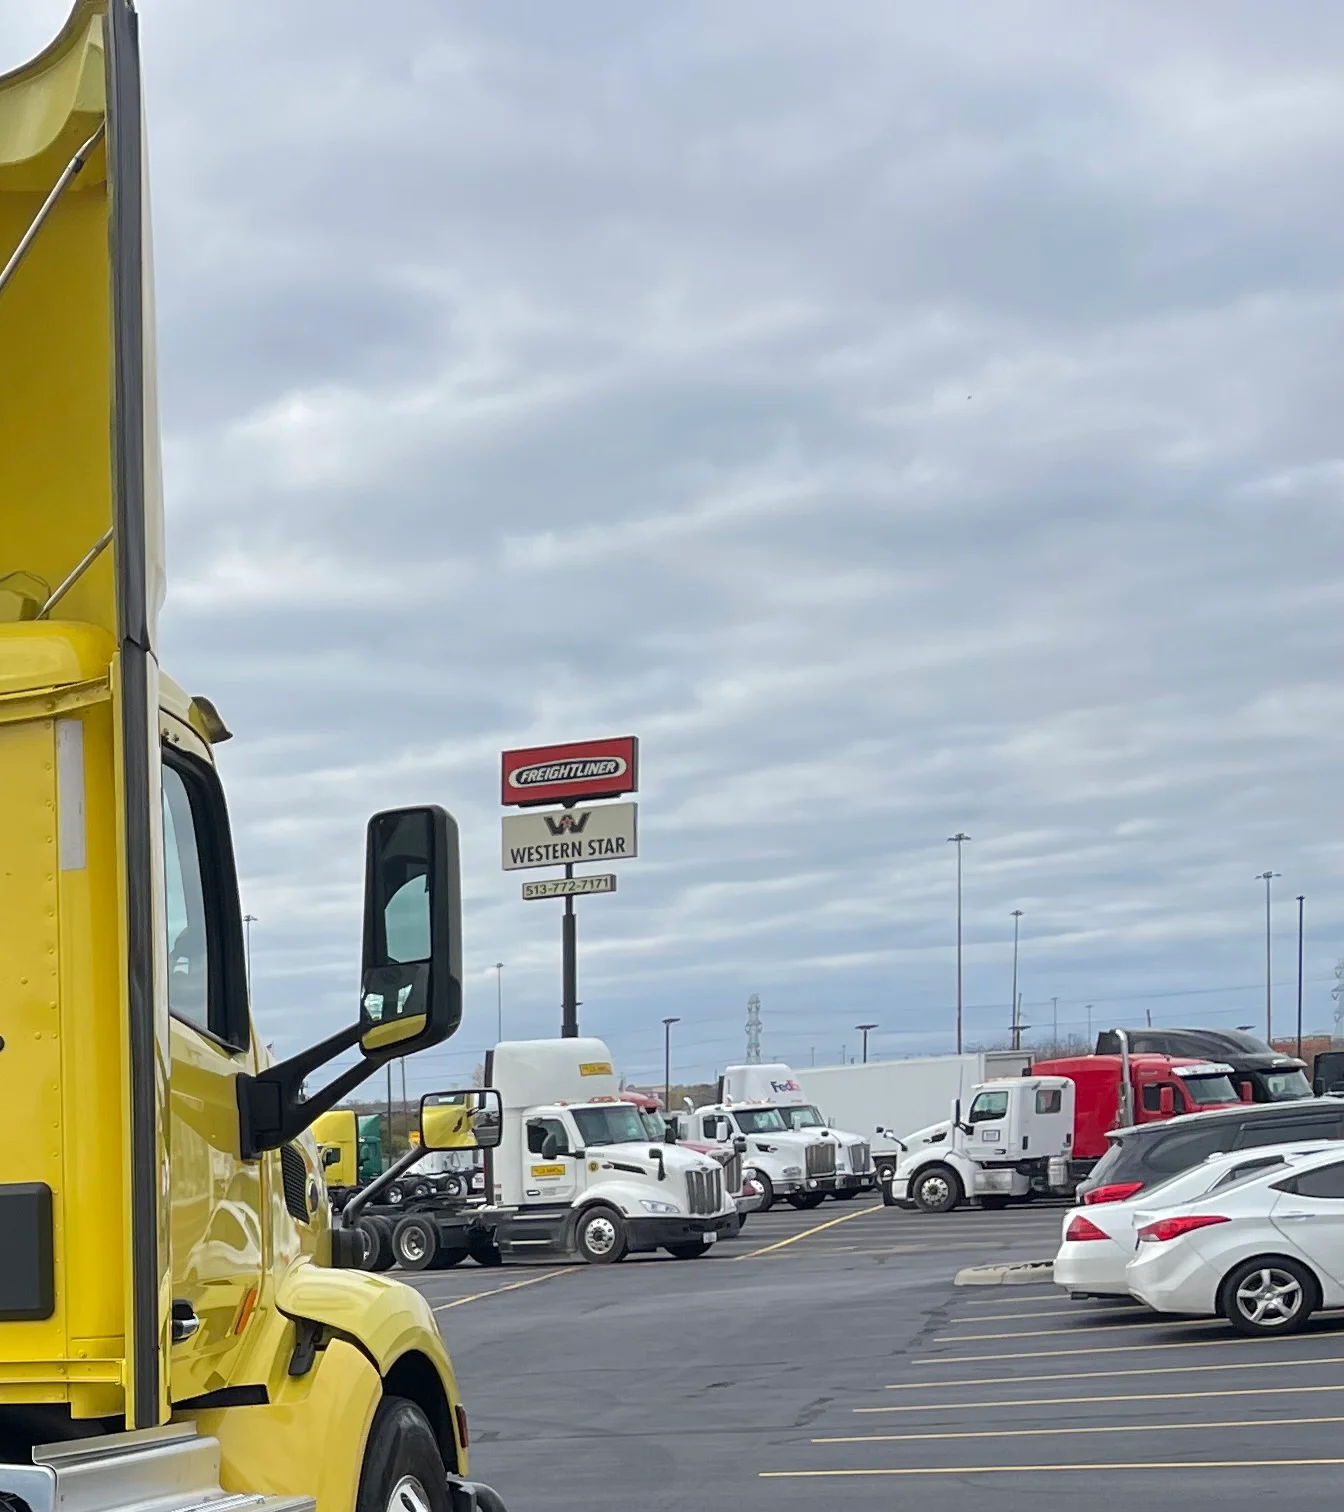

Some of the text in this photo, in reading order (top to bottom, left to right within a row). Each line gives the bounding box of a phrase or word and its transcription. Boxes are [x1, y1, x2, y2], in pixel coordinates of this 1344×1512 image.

[520, 761, 616, 784] FREIGHTLINER
[511, 837, 625, 864] WESTERN STAR
[525, 878, 609, 896] 513-772-7171
